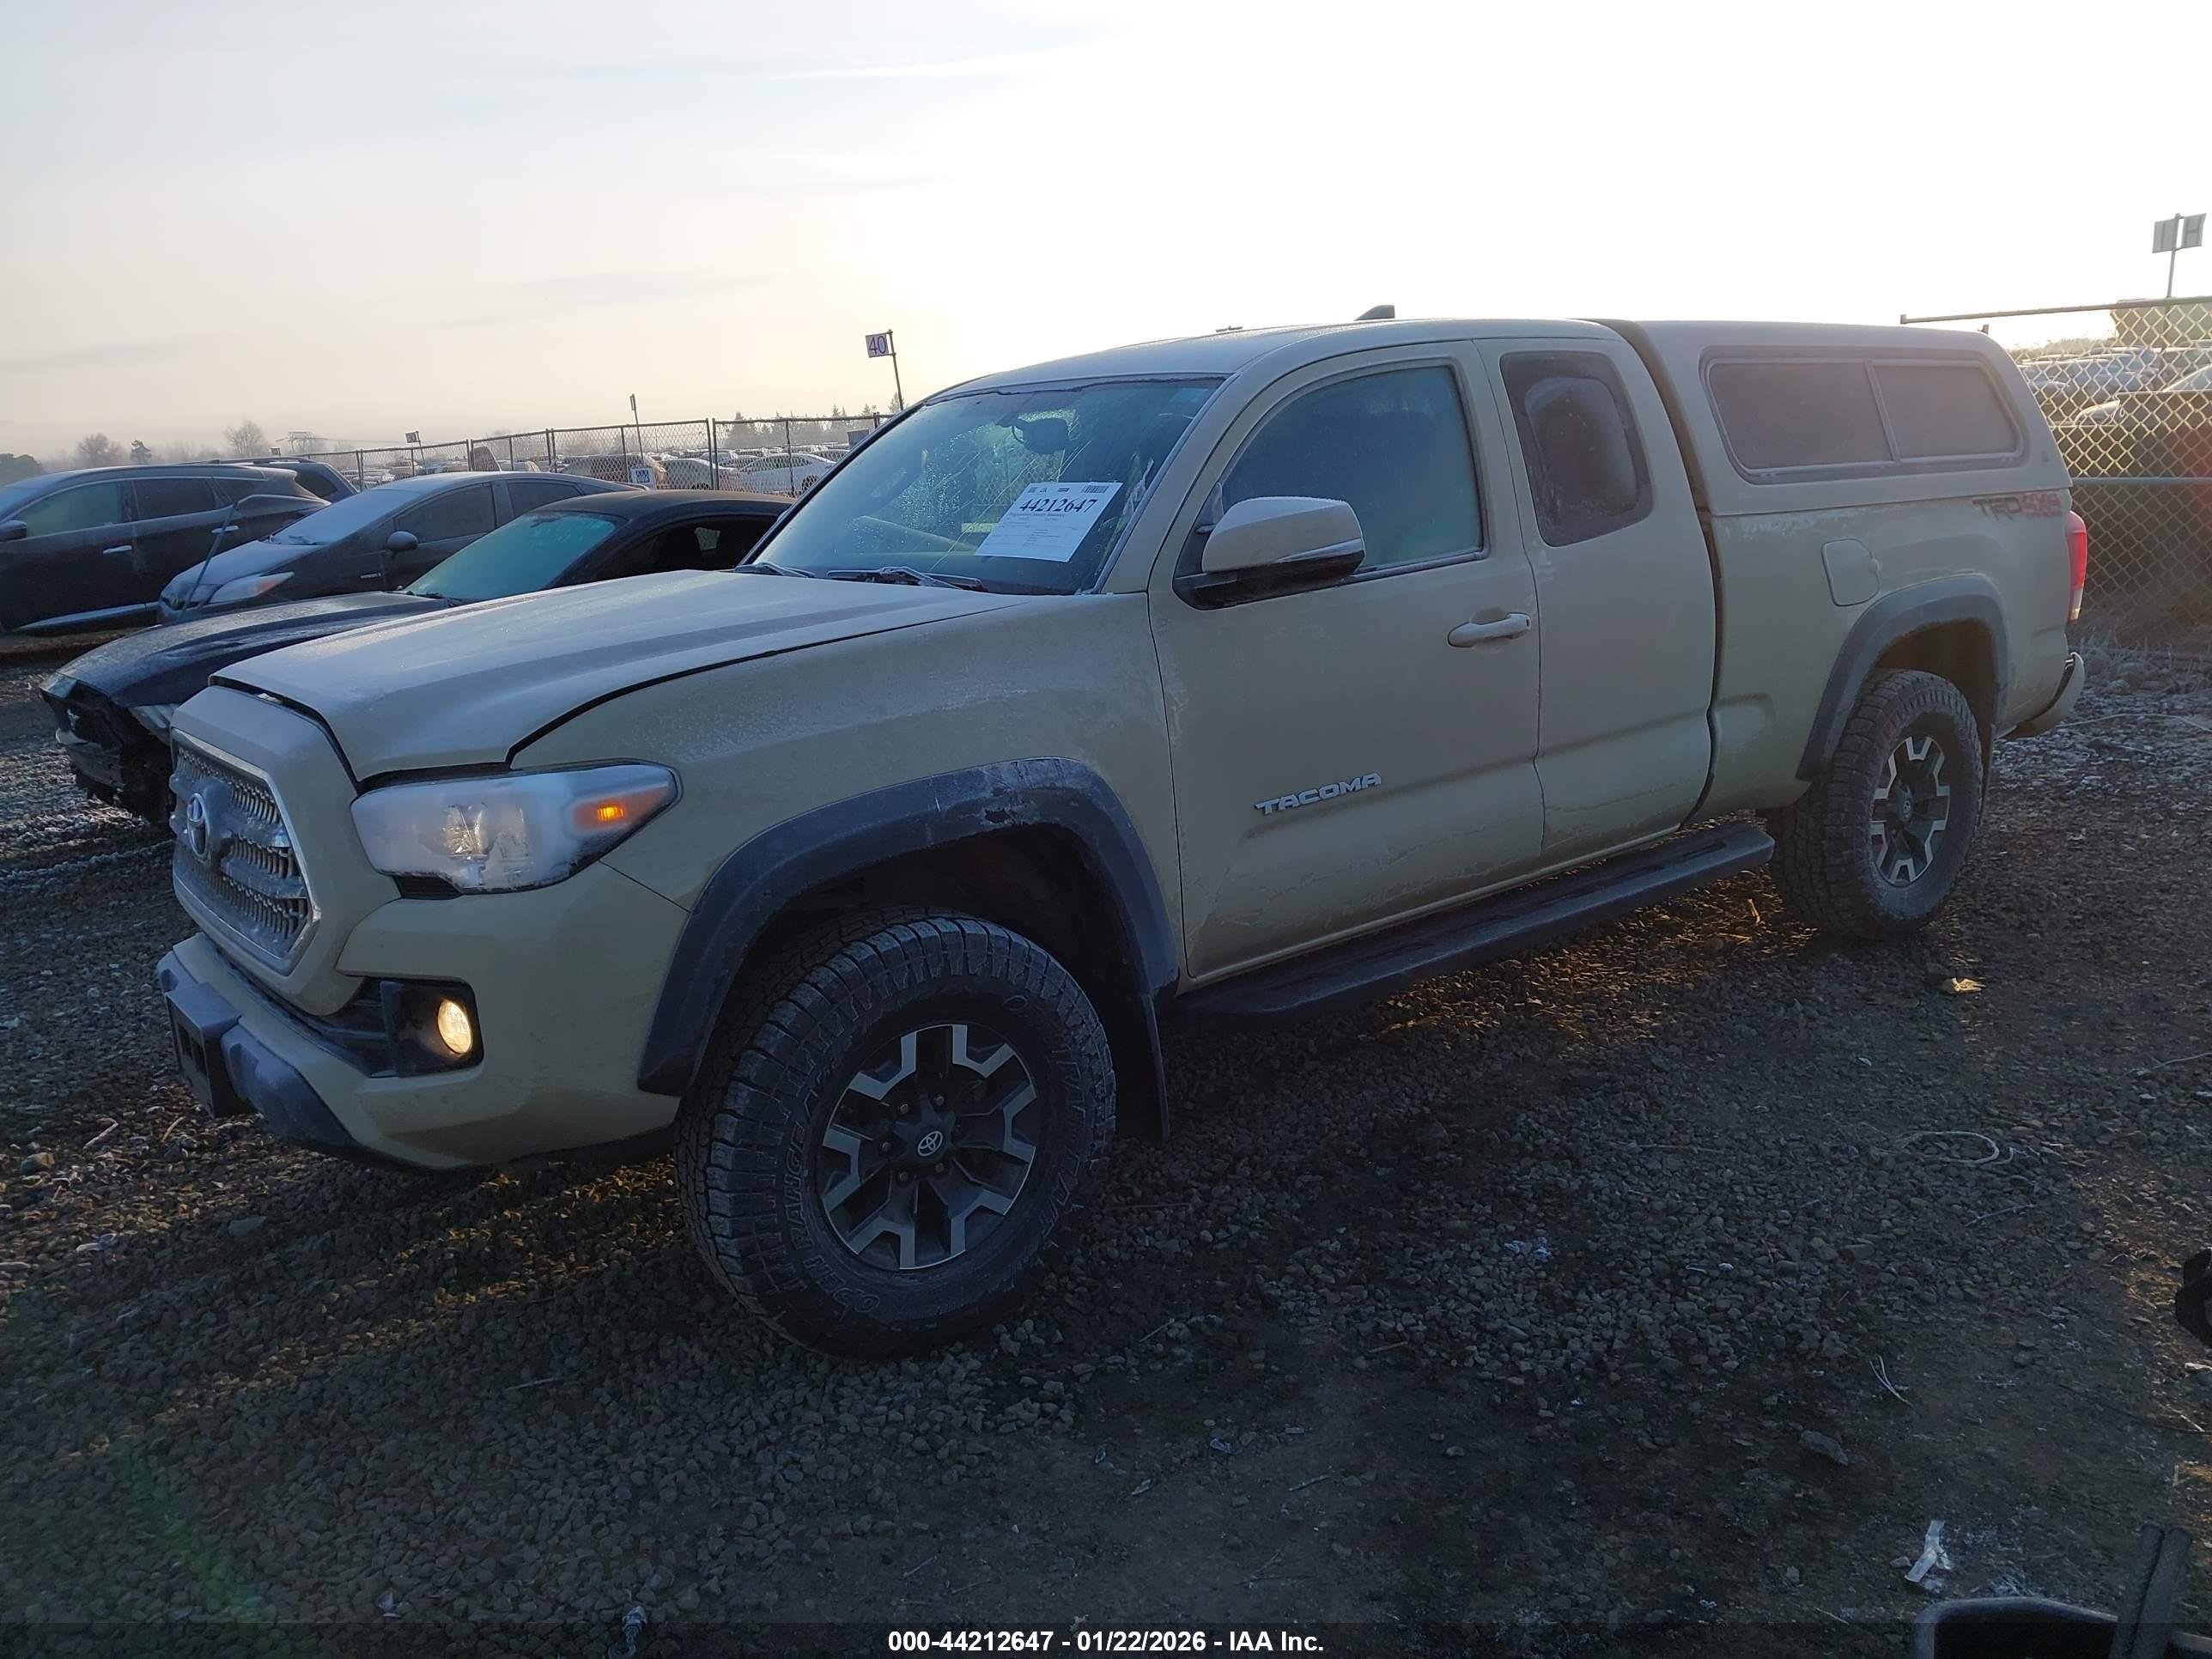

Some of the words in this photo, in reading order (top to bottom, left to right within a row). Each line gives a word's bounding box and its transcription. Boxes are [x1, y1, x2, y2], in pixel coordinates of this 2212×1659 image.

[869, 336, 887, 355] 40
[1018, 498, 1099, 514] 44212647
[1254, 772, 1382, 815] TACOMA
[783, 1120, 815, 1251] RANGE
